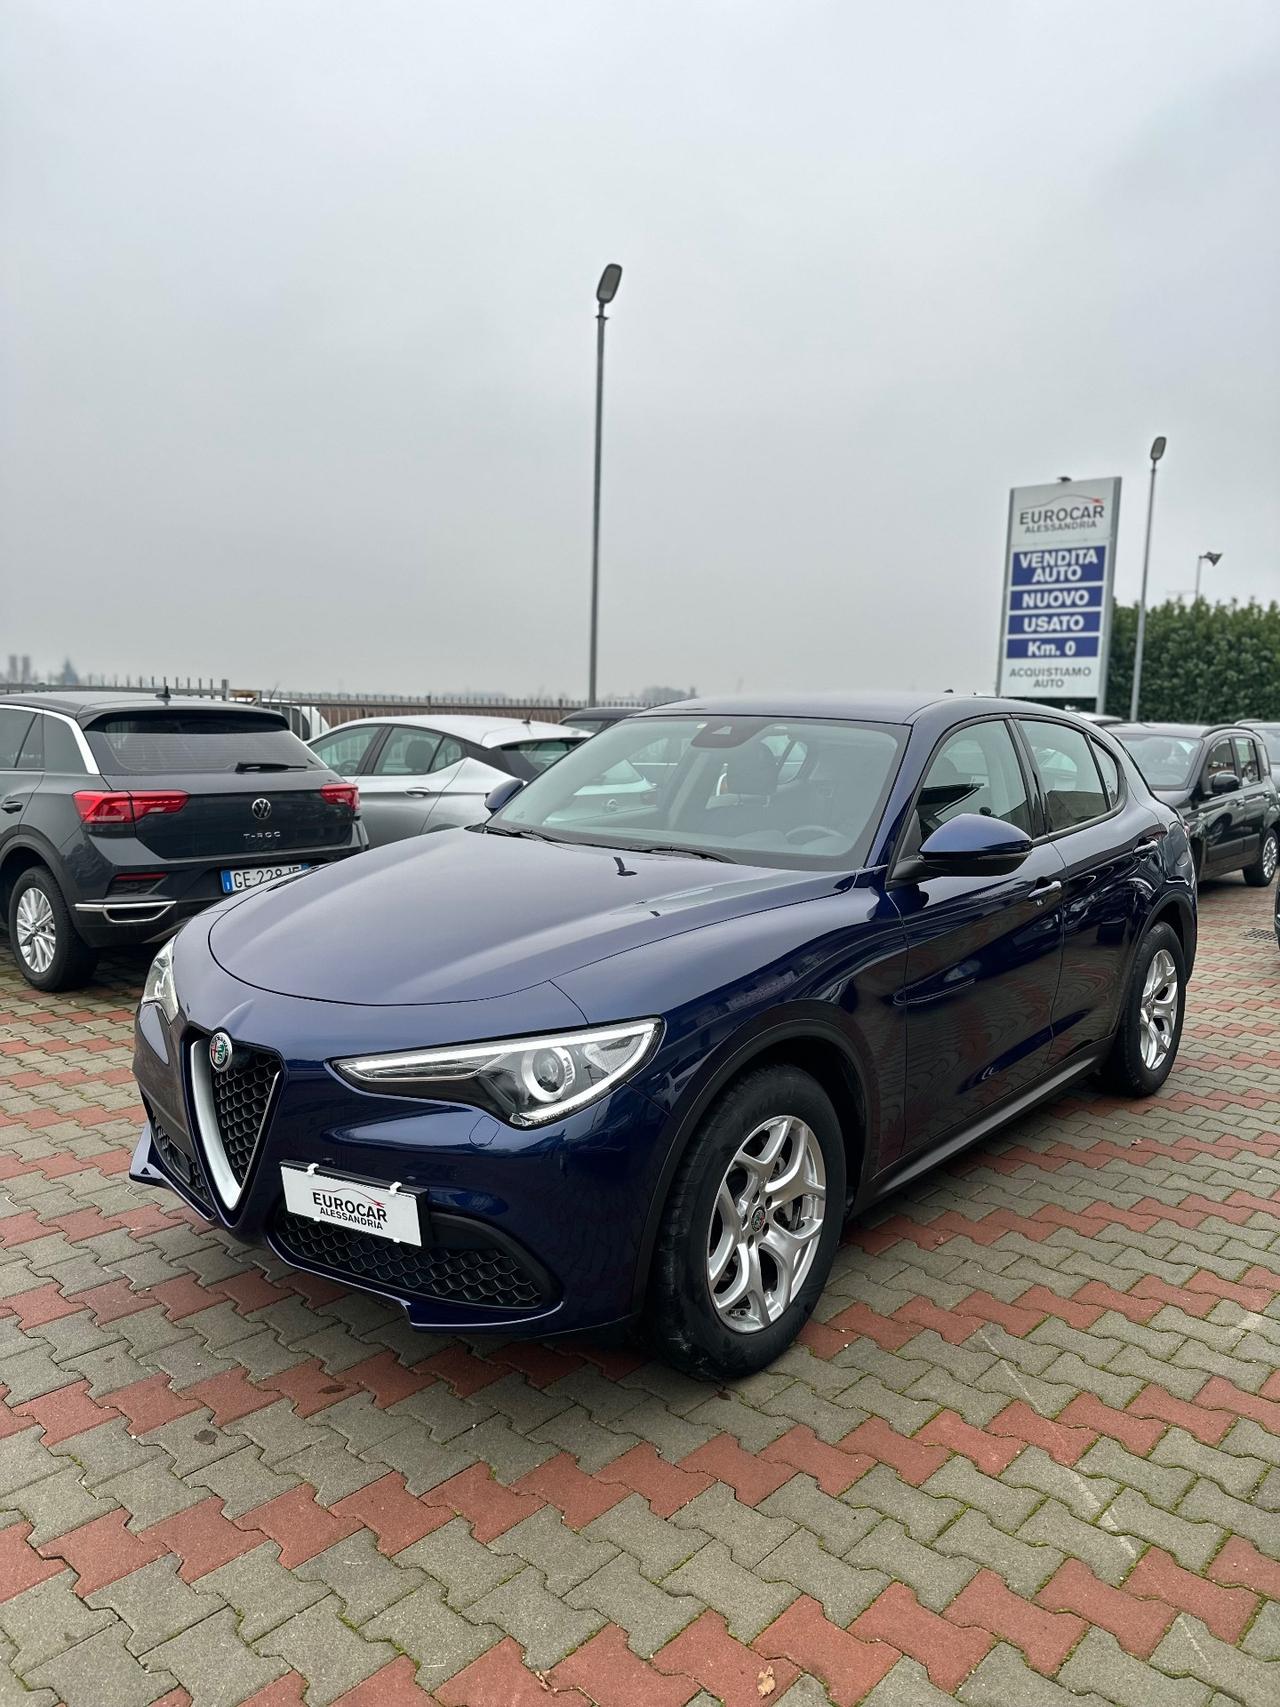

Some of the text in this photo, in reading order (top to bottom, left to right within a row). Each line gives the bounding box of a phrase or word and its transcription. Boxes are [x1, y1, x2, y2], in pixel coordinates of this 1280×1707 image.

[1019, 505, 1105, 525] EUROCAR
[1024, 521, 1097, 534] ALESSANDRIA
[1019, 549, 1098, 568] VENDITA
[1032, 566, 1082, 583] AUTO
[1022, 590, 1089, 608] NUOVO
[1023, 615, 1085, 633] USATO
[1027, 640, 1076, 657] Km. 0
[1009, 667, 1092, 678] ACQUISTIAMO
[1034, 679, 1064, 689] AUTO
[243, 831, 281, 839] T-ROC
[312, 1191, 388, 1223] EUROCAR
[320, 1207, 384, 1231] ALESSANDRIA
